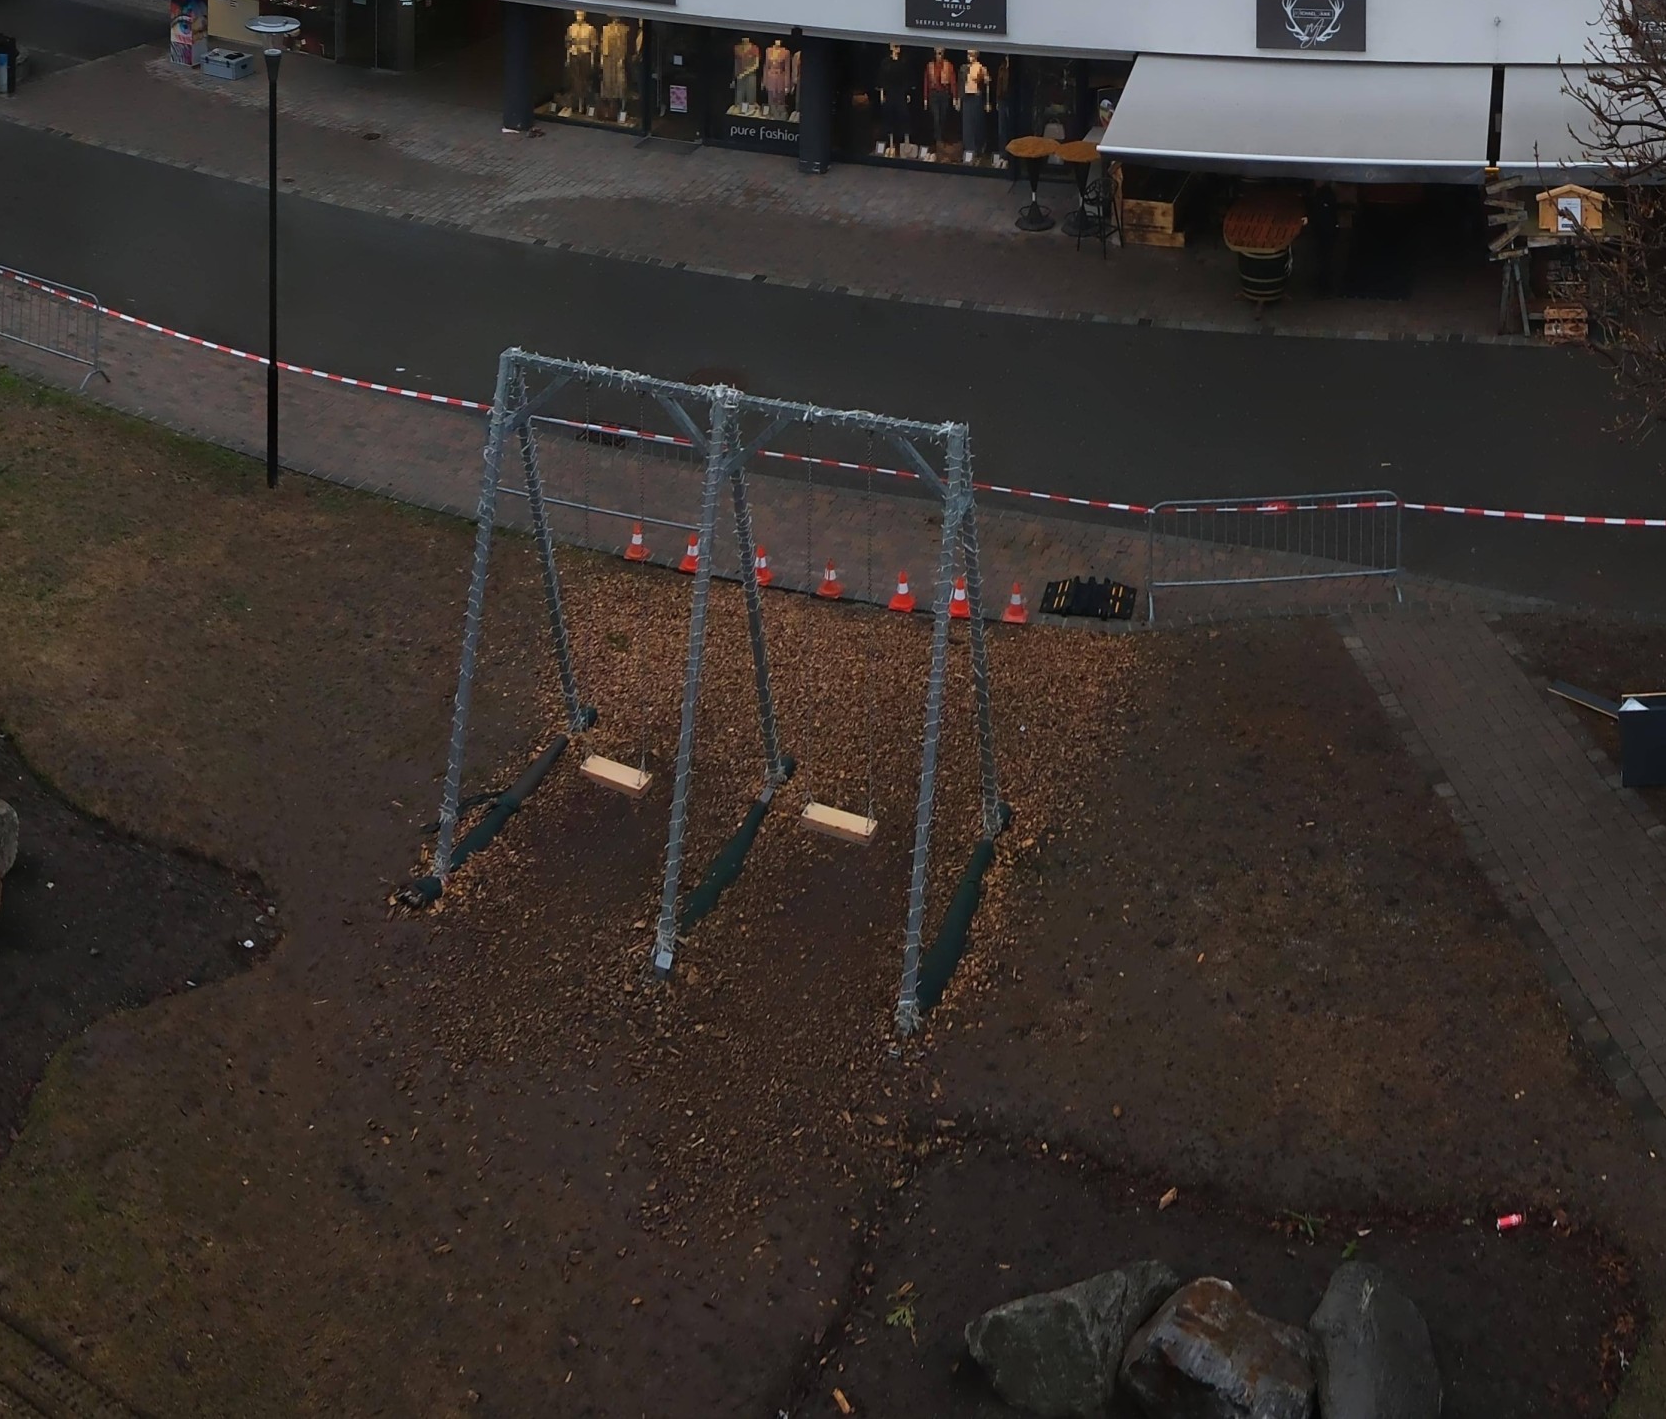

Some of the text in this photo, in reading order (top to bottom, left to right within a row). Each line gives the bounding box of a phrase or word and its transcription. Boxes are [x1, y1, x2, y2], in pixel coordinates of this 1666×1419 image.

[942, 3, 972, 11] SEEFELD
[915, 19, 944, 27] SEEFELD
[946, 21, 982, 29] SHOPPING
[730, 125, 756, 137] pure
